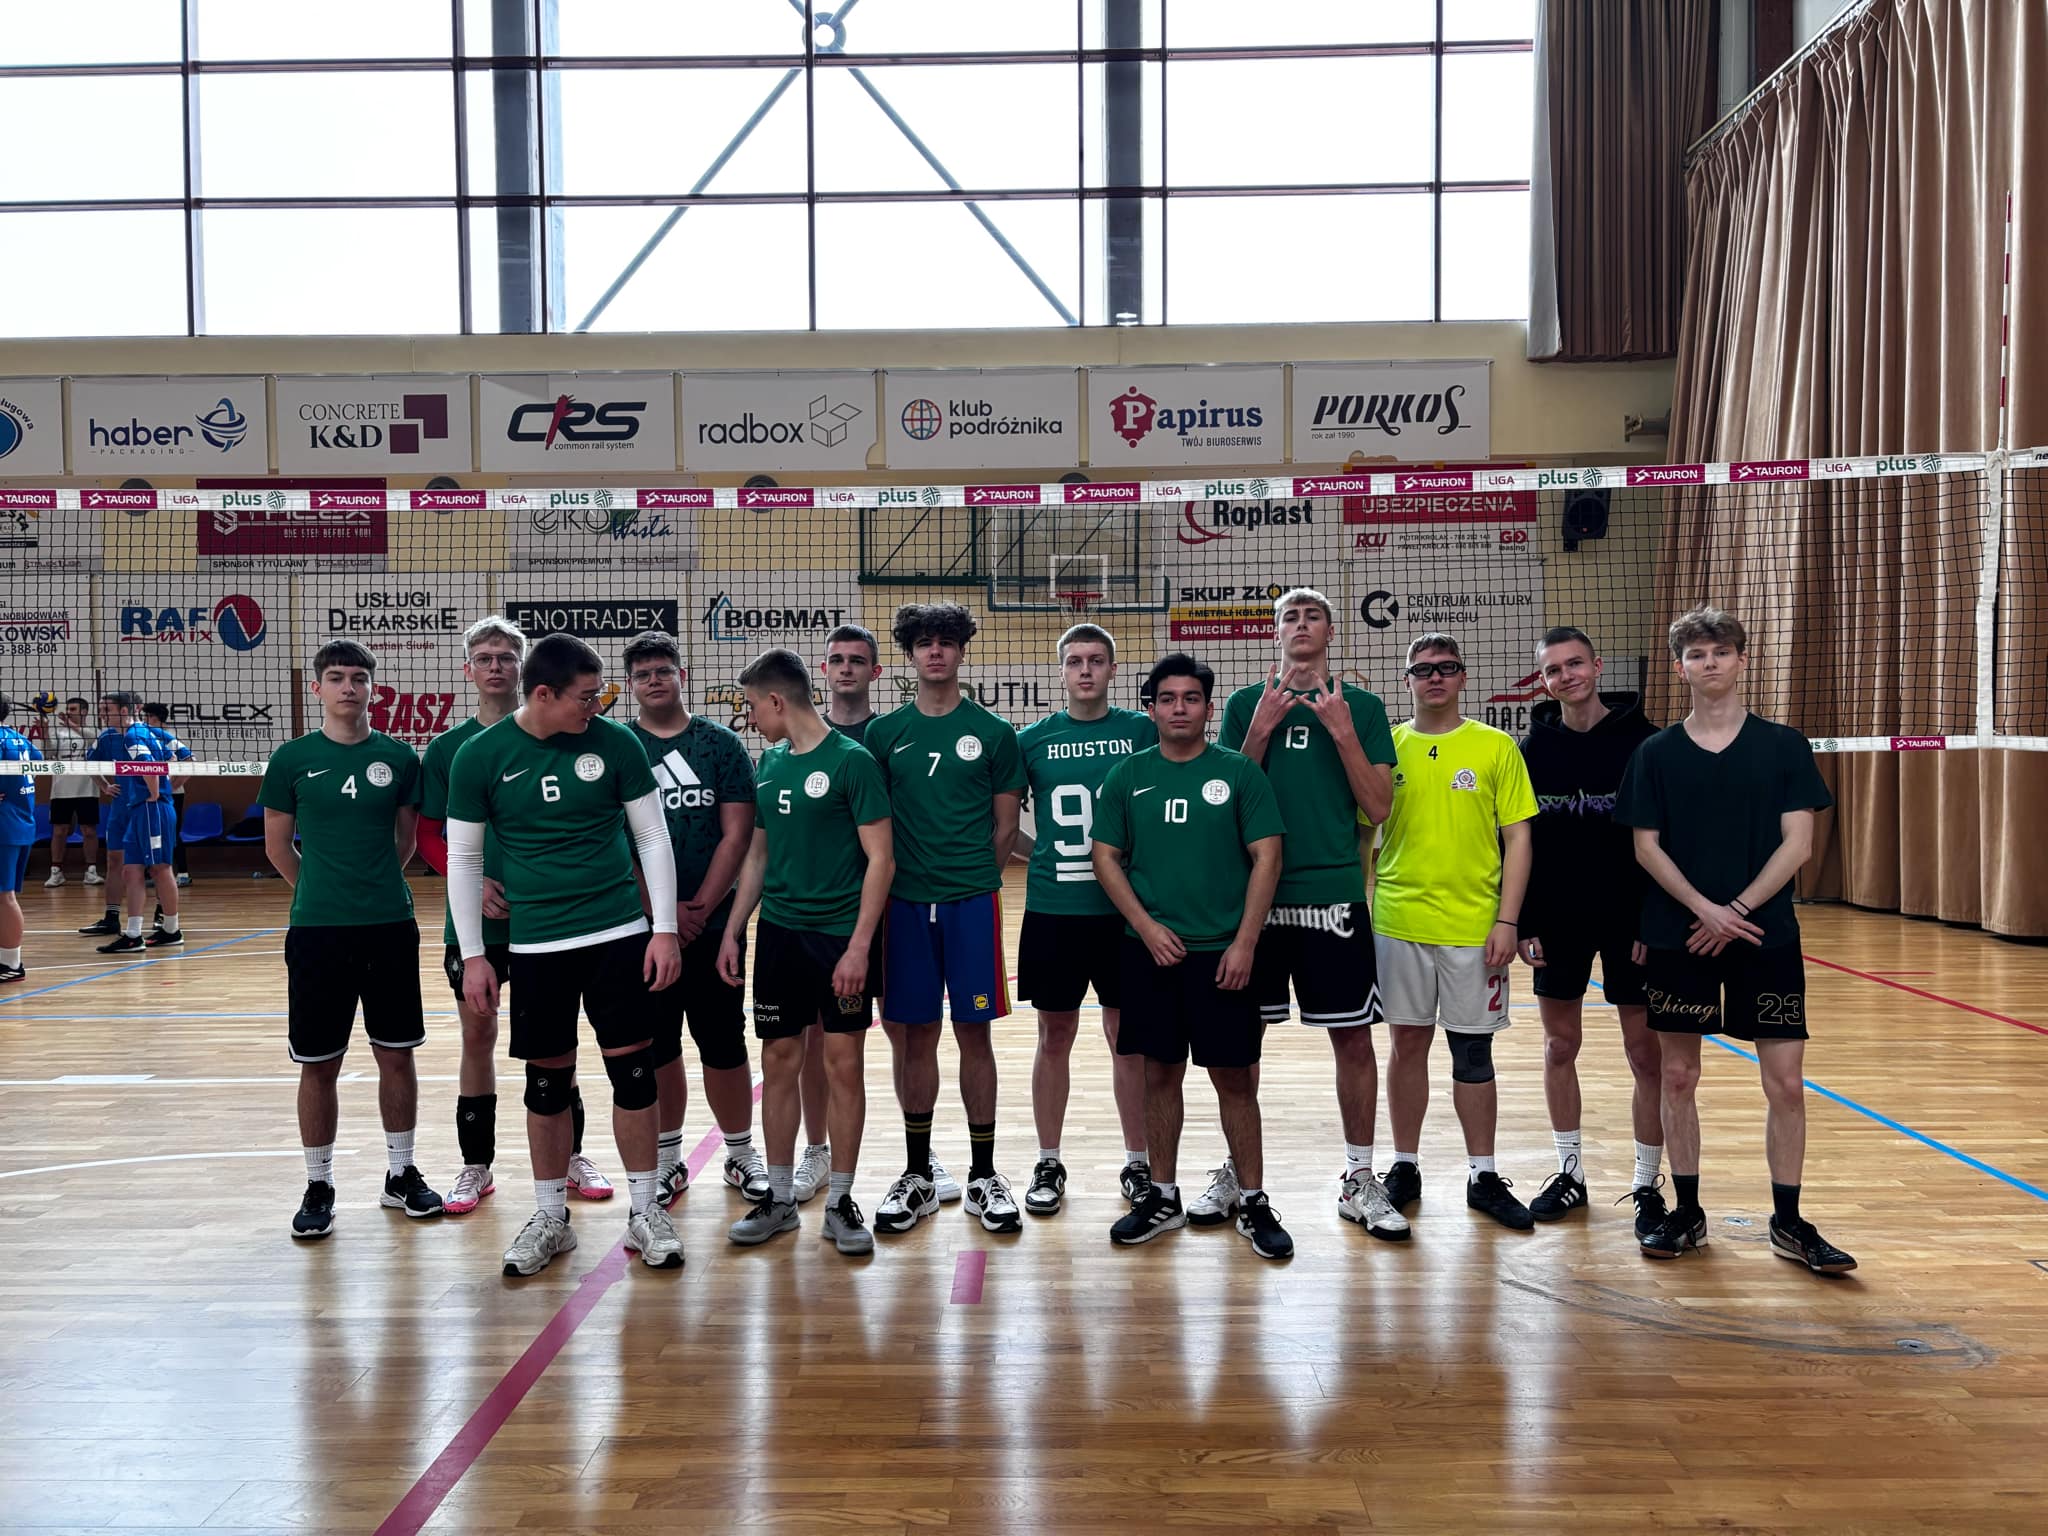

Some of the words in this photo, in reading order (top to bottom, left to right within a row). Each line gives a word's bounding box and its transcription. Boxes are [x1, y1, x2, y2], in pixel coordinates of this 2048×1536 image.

[299, 404, 400, 421] CONCRETE
[950, 400, 992, 417] klub
[1313, 385, 1465, 435] PORKOS
[90, 418, 193, 446] haber
[310, 425, 382, 448] K&D
[699, 413, 804, 444] radbox
[950, 417, 1063, 438] podróżnika
[554, 442, 590, 450] common
[591, 441, 605, 449] rail
[606, 441, 634, 451] system
[1182, 437, 1203, 447] TWÓJ
[1206, 436, 1262, 447] BIUROSERWIS
[1653, 469, 1698, 480] TAURON
[1755, 465, 1802, 476] TAURON
[1825, 462, 1852, 473] LIGA
[1876, 456, 1917, 475] plus
[1318, 481, 1364, 491] TAURON
[1420, 477, 1466, 487] TAURON
[1488, 475, 1515, 485] LIGA
[1538, 469, 1578, 488] plus
[662, 493, 707, 504] TAURON
[762, 493, 807, 502] TAURON
[829, 493, 855, 502] LIGA
[878, 488, 917, 506] plus
[988, 490, 1034, 500] TAURON
[1088, 487, 1134, 498] TAURON
[1156, 486, 1182, 496] LIGA
[1205, 480, 1244, 499] plus
[4, 494, 50, 504] TAURON
[105, 494, 150, 504] TAURON
[173, 495, 199, 504] LIGA
[223, 490, 262, 508] plus
[334, 496, 380, 505] TAURON
[433, 495, 480, 504] TAURON
[501, 495, 527, 504] LIGA
[550, 490, 589, 508] plus
[1362, 496, 1516, 514] UBEZPIECZENIA
[1213, 499, 1312, 531] Roplast
[213, 560, 254, 568] SPONSOR
[356, 591, 430, 608] USŁUGI
[1181, 587, 1234, 601] SKUP
[1407, 595, 1470, 606] CENTRUM
[1475, 594, 1532, 606] KULTURY
[121, 607, 210, 636] RAF
[328, 608, 458, 631] DEKARSKIE
[518, 608, 665, 631] ENOTRADEX
[724, 609, 846, 629] BOGMAT
[1423, 609, 1478, 623] ŚWIECIU
[1180, 624, 1231, 635] ŚWIECIE
[1243, 624, 1278, 634] RAJD
[1285, 725, 1309, 749] 13
[1047, 739, 1133, 760] HOUSTON
[1428, 745, 1438, 760] 4
[21, 762, 49, 774] plus
[132, 765, 164, 773] TAURON
[218, 762, 247, 774] plus
[928, 752, 941, 776] 7
[341, 774, 358, 799] 4
[541, 775, 561, 802] 6
[661, 786, 715, 810] idas
[778, 789, 792, 815] 5
[1051, 783, 1104, 857] 9
[1164, 798, 1188, 824] 10
[1487, 974, 1508, 1012] 2
[1757, 993, 1803, 1025] 23
